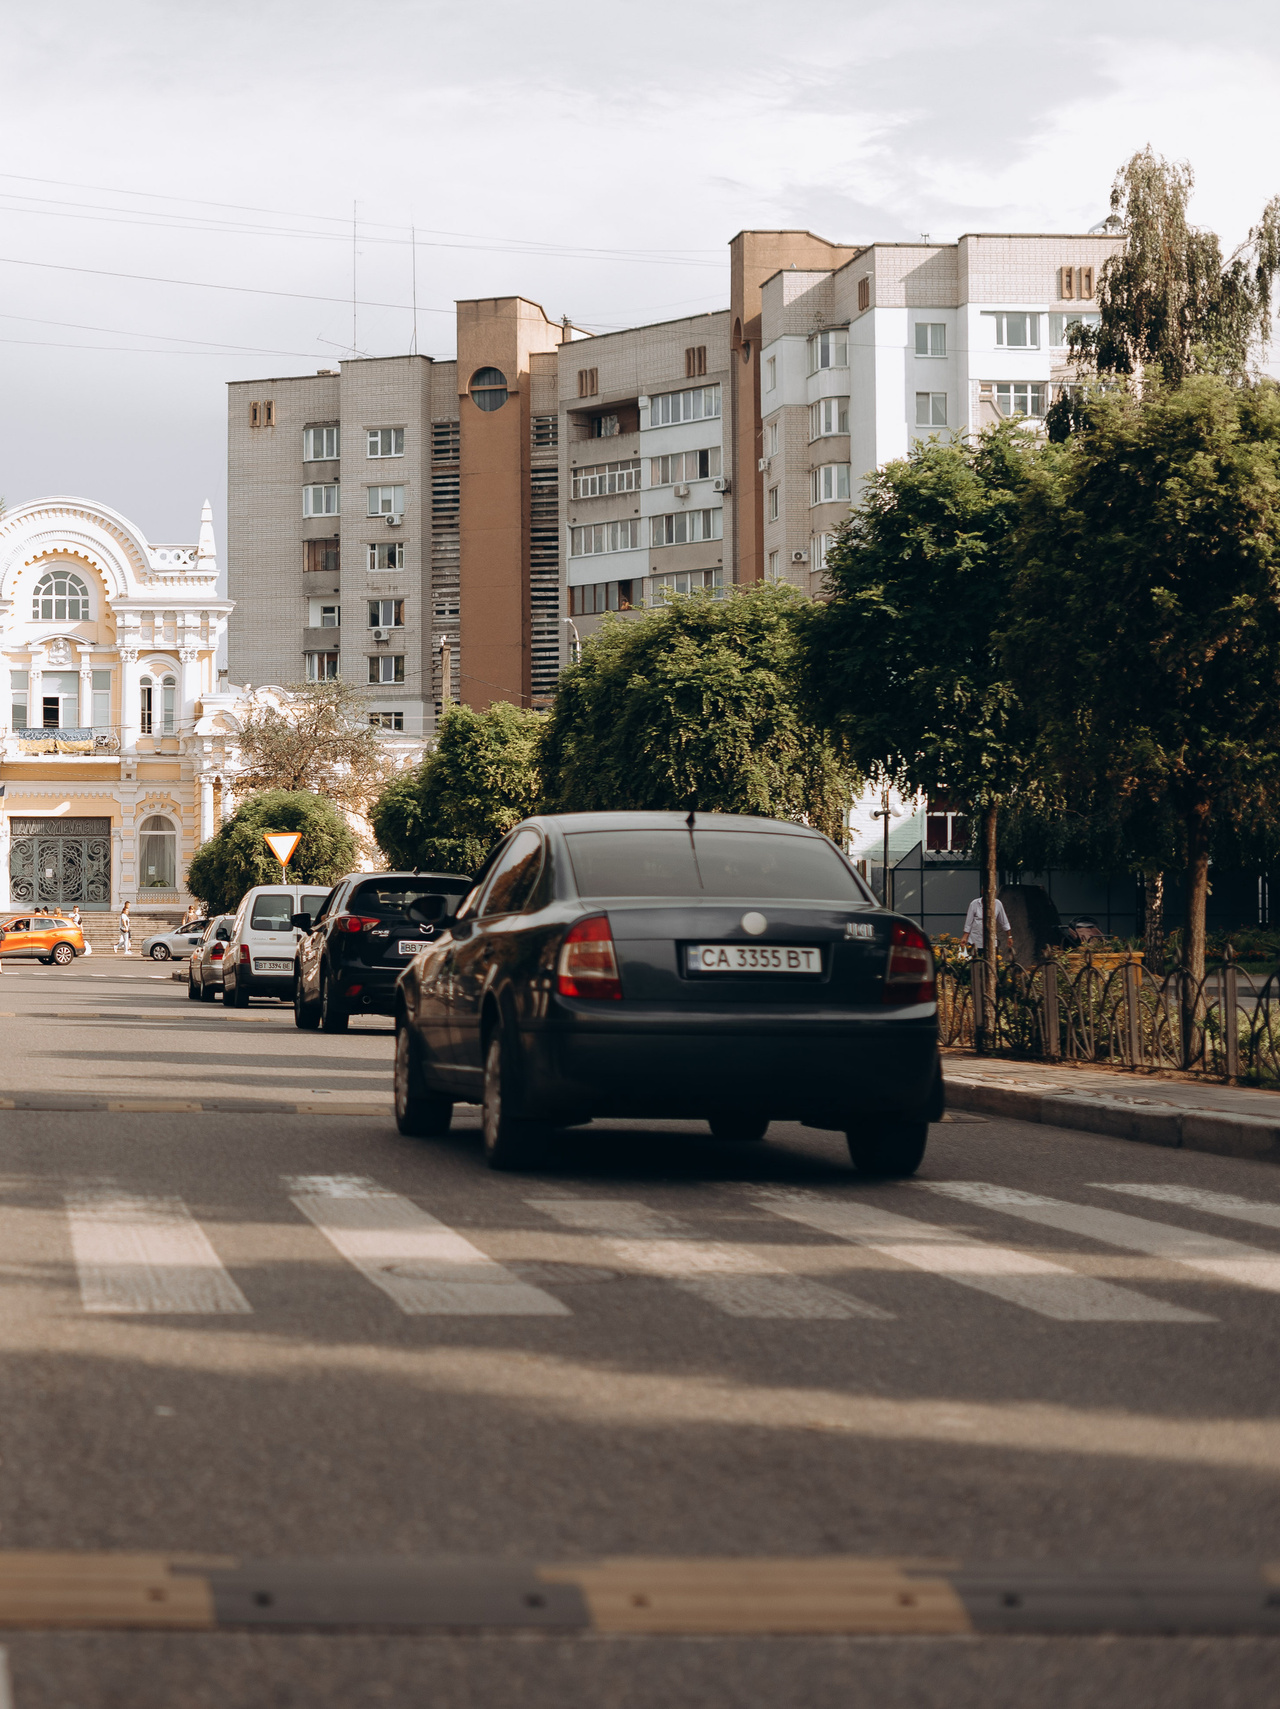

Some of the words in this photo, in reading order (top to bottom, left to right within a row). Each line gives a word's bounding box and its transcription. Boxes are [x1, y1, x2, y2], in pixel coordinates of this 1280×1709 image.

[701, 949, 731, 968] CA
[736, 949, 782, 968] 3355
[787, 950, 815, 969] BT
